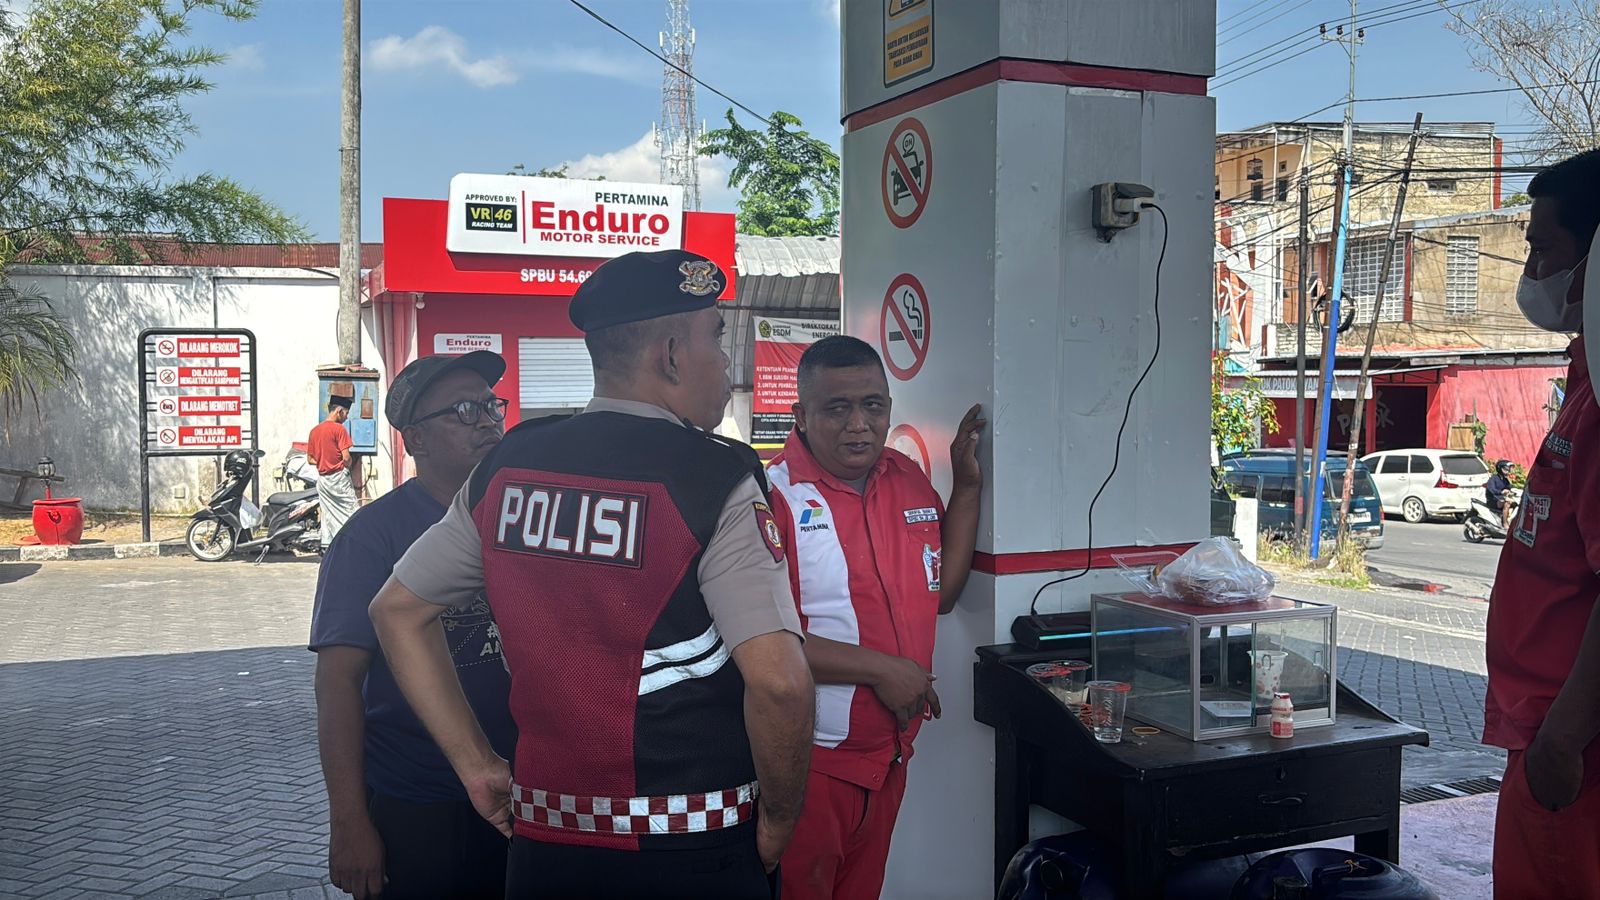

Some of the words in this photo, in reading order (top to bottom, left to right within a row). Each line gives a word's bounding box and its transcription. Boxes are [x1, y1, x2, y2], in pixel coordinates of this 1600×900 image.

[465, 193, 500, 202] APPROVED
[502, 195, 517, 203] BY:
[595, 192, 669, 207] PERTAMINA
[470, 207, 491, 220] VR
[494, 208, 512, 221] 46
[532, 201, 670, 235] Enduro
[471, 221, 495, 229] RACING
[540, 232, 593, 244] MOTOR
[598, 234, 660, 246] SERVICE
[520, 269, 556, 283] SPBU
[772, 329, 791, 337] ESDM
[180, 342, 209, 353] DILARANG
[446, 339, 491, 347] Enduro
[191, 369, 228, 377] DILARANG
[1272, 377, 1298, 391] PATOK
[194, 428, 226, 436] DILARANG
[226, 435, 238, 443] API
[497, 487, 639, 560] POLISI
